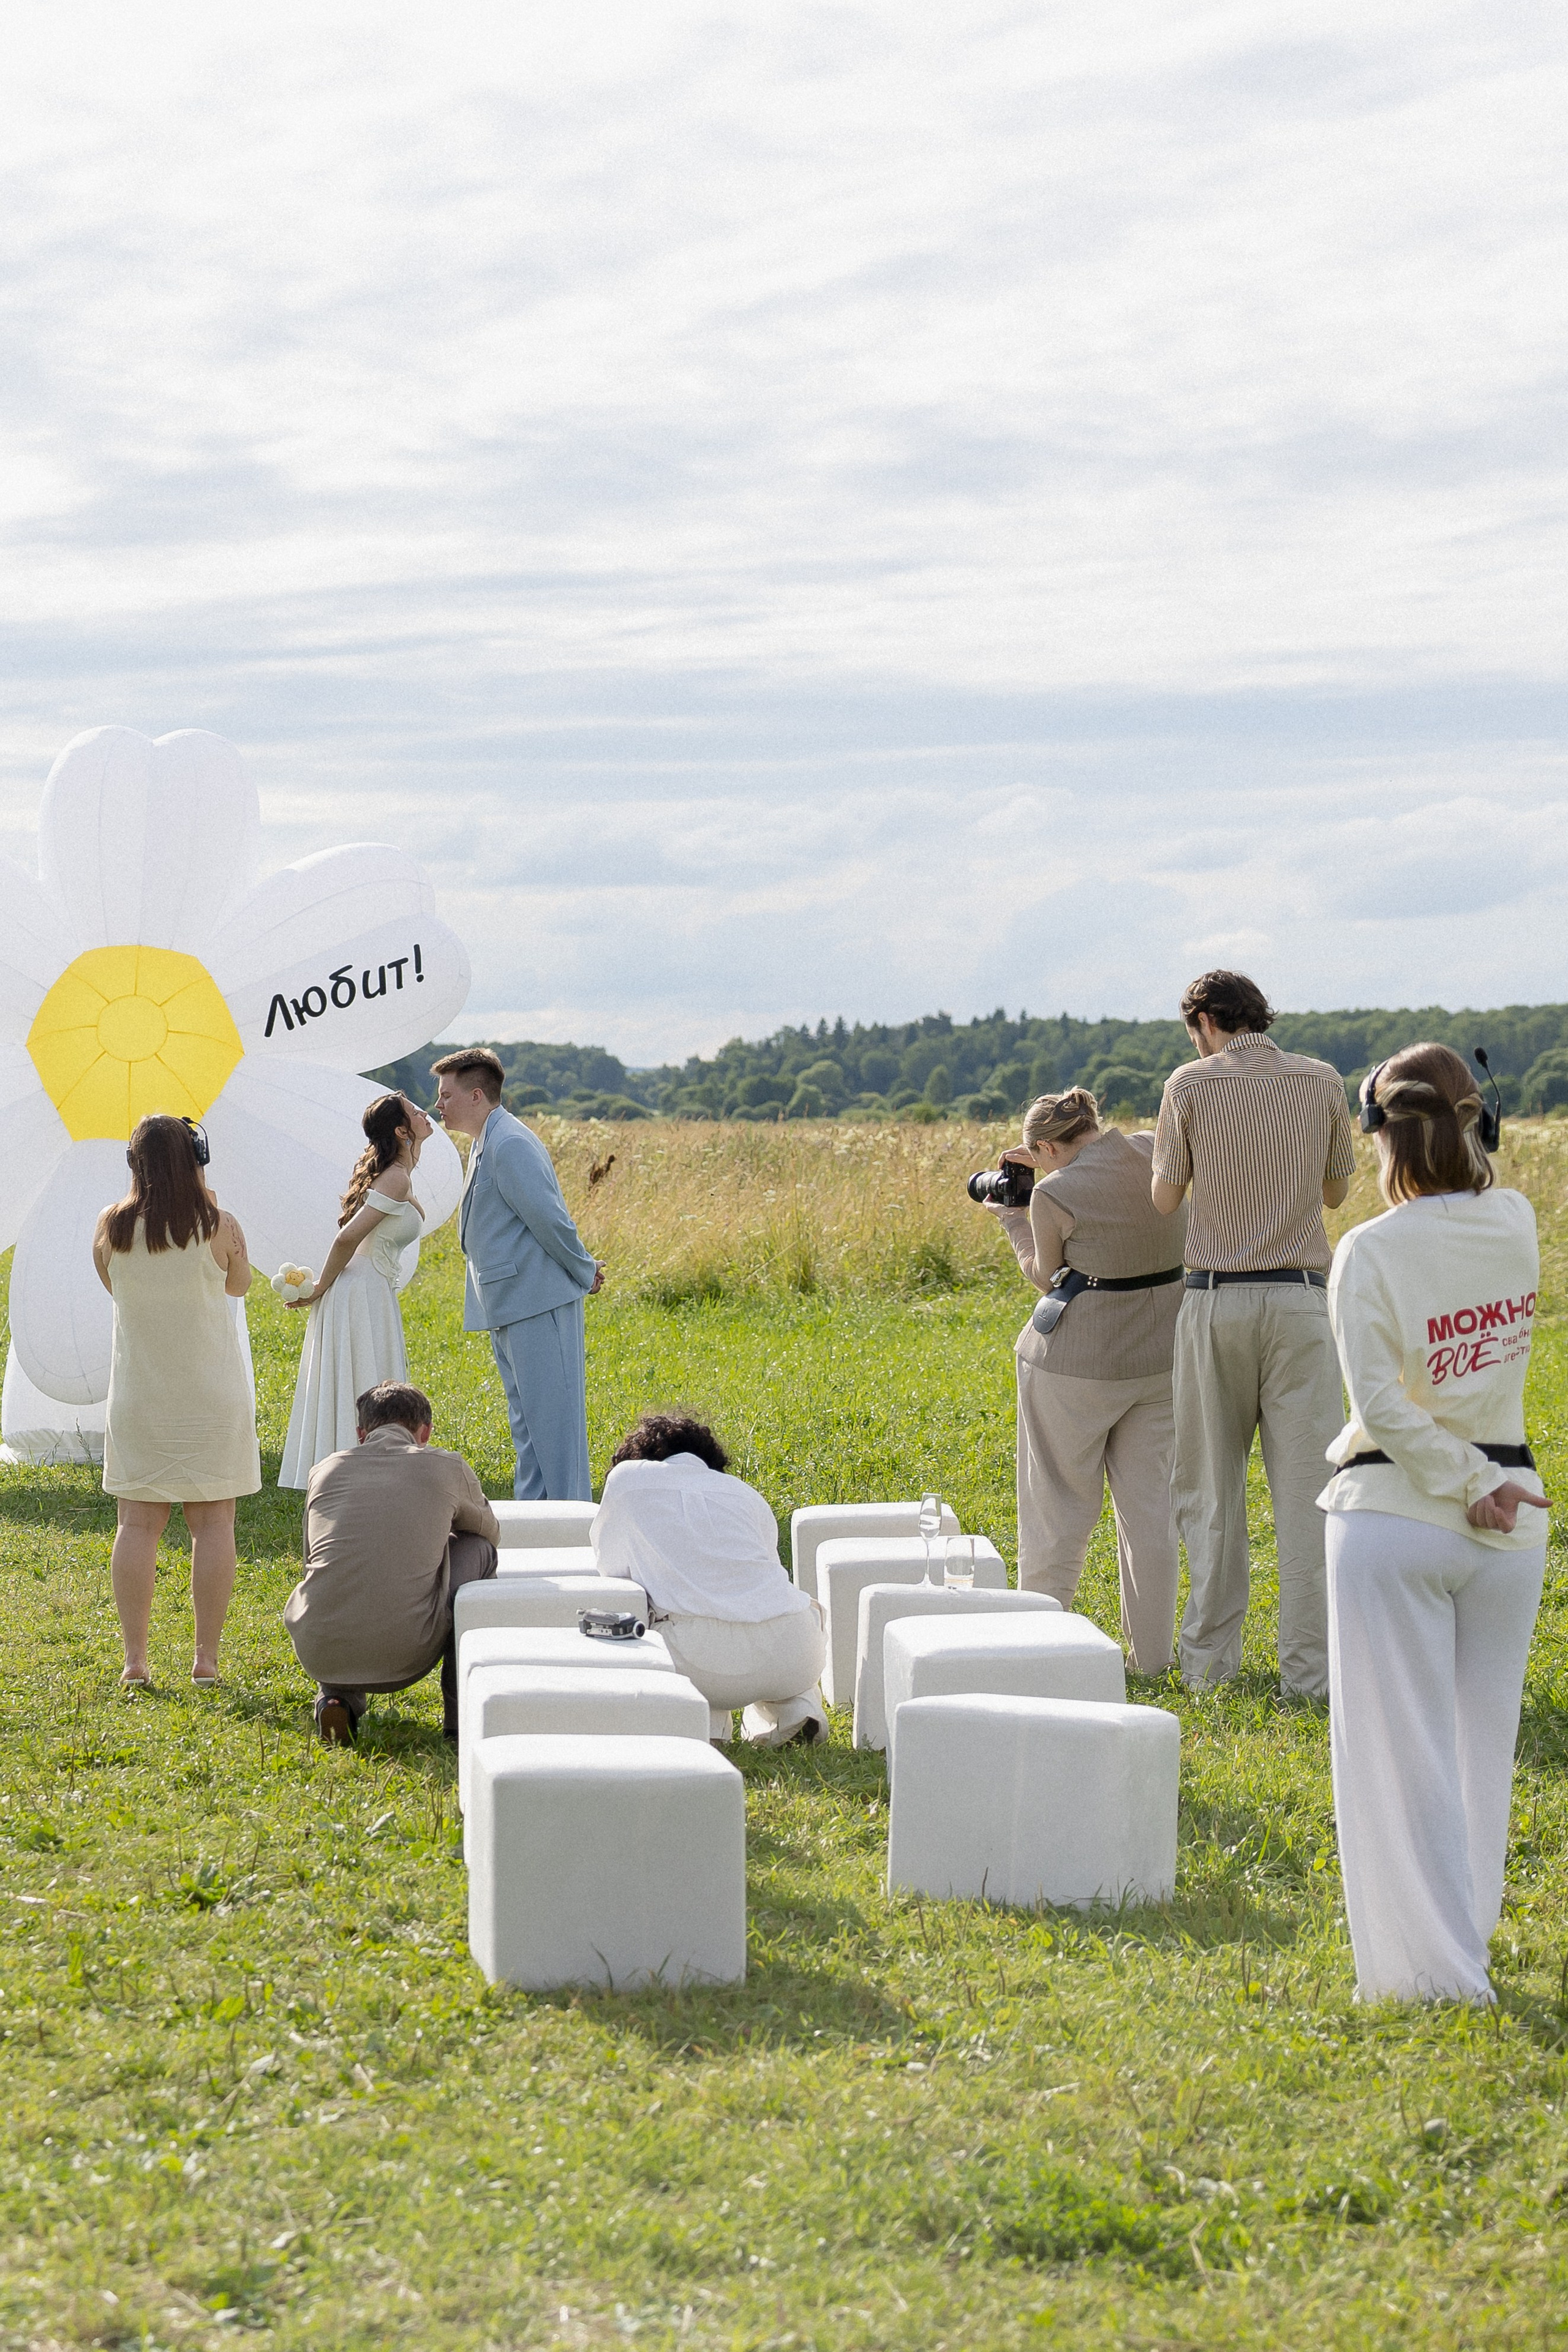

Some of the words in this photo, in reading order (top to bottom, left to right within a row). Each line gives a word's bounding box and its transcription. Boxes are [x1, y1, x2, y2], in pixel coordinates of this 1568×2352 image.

[264, 944, 424, 1038] Любит!
[1427, 1292, 1536, 1344] МОЖНО
[1427, 1332, 1501, 1385] ВСЁ
